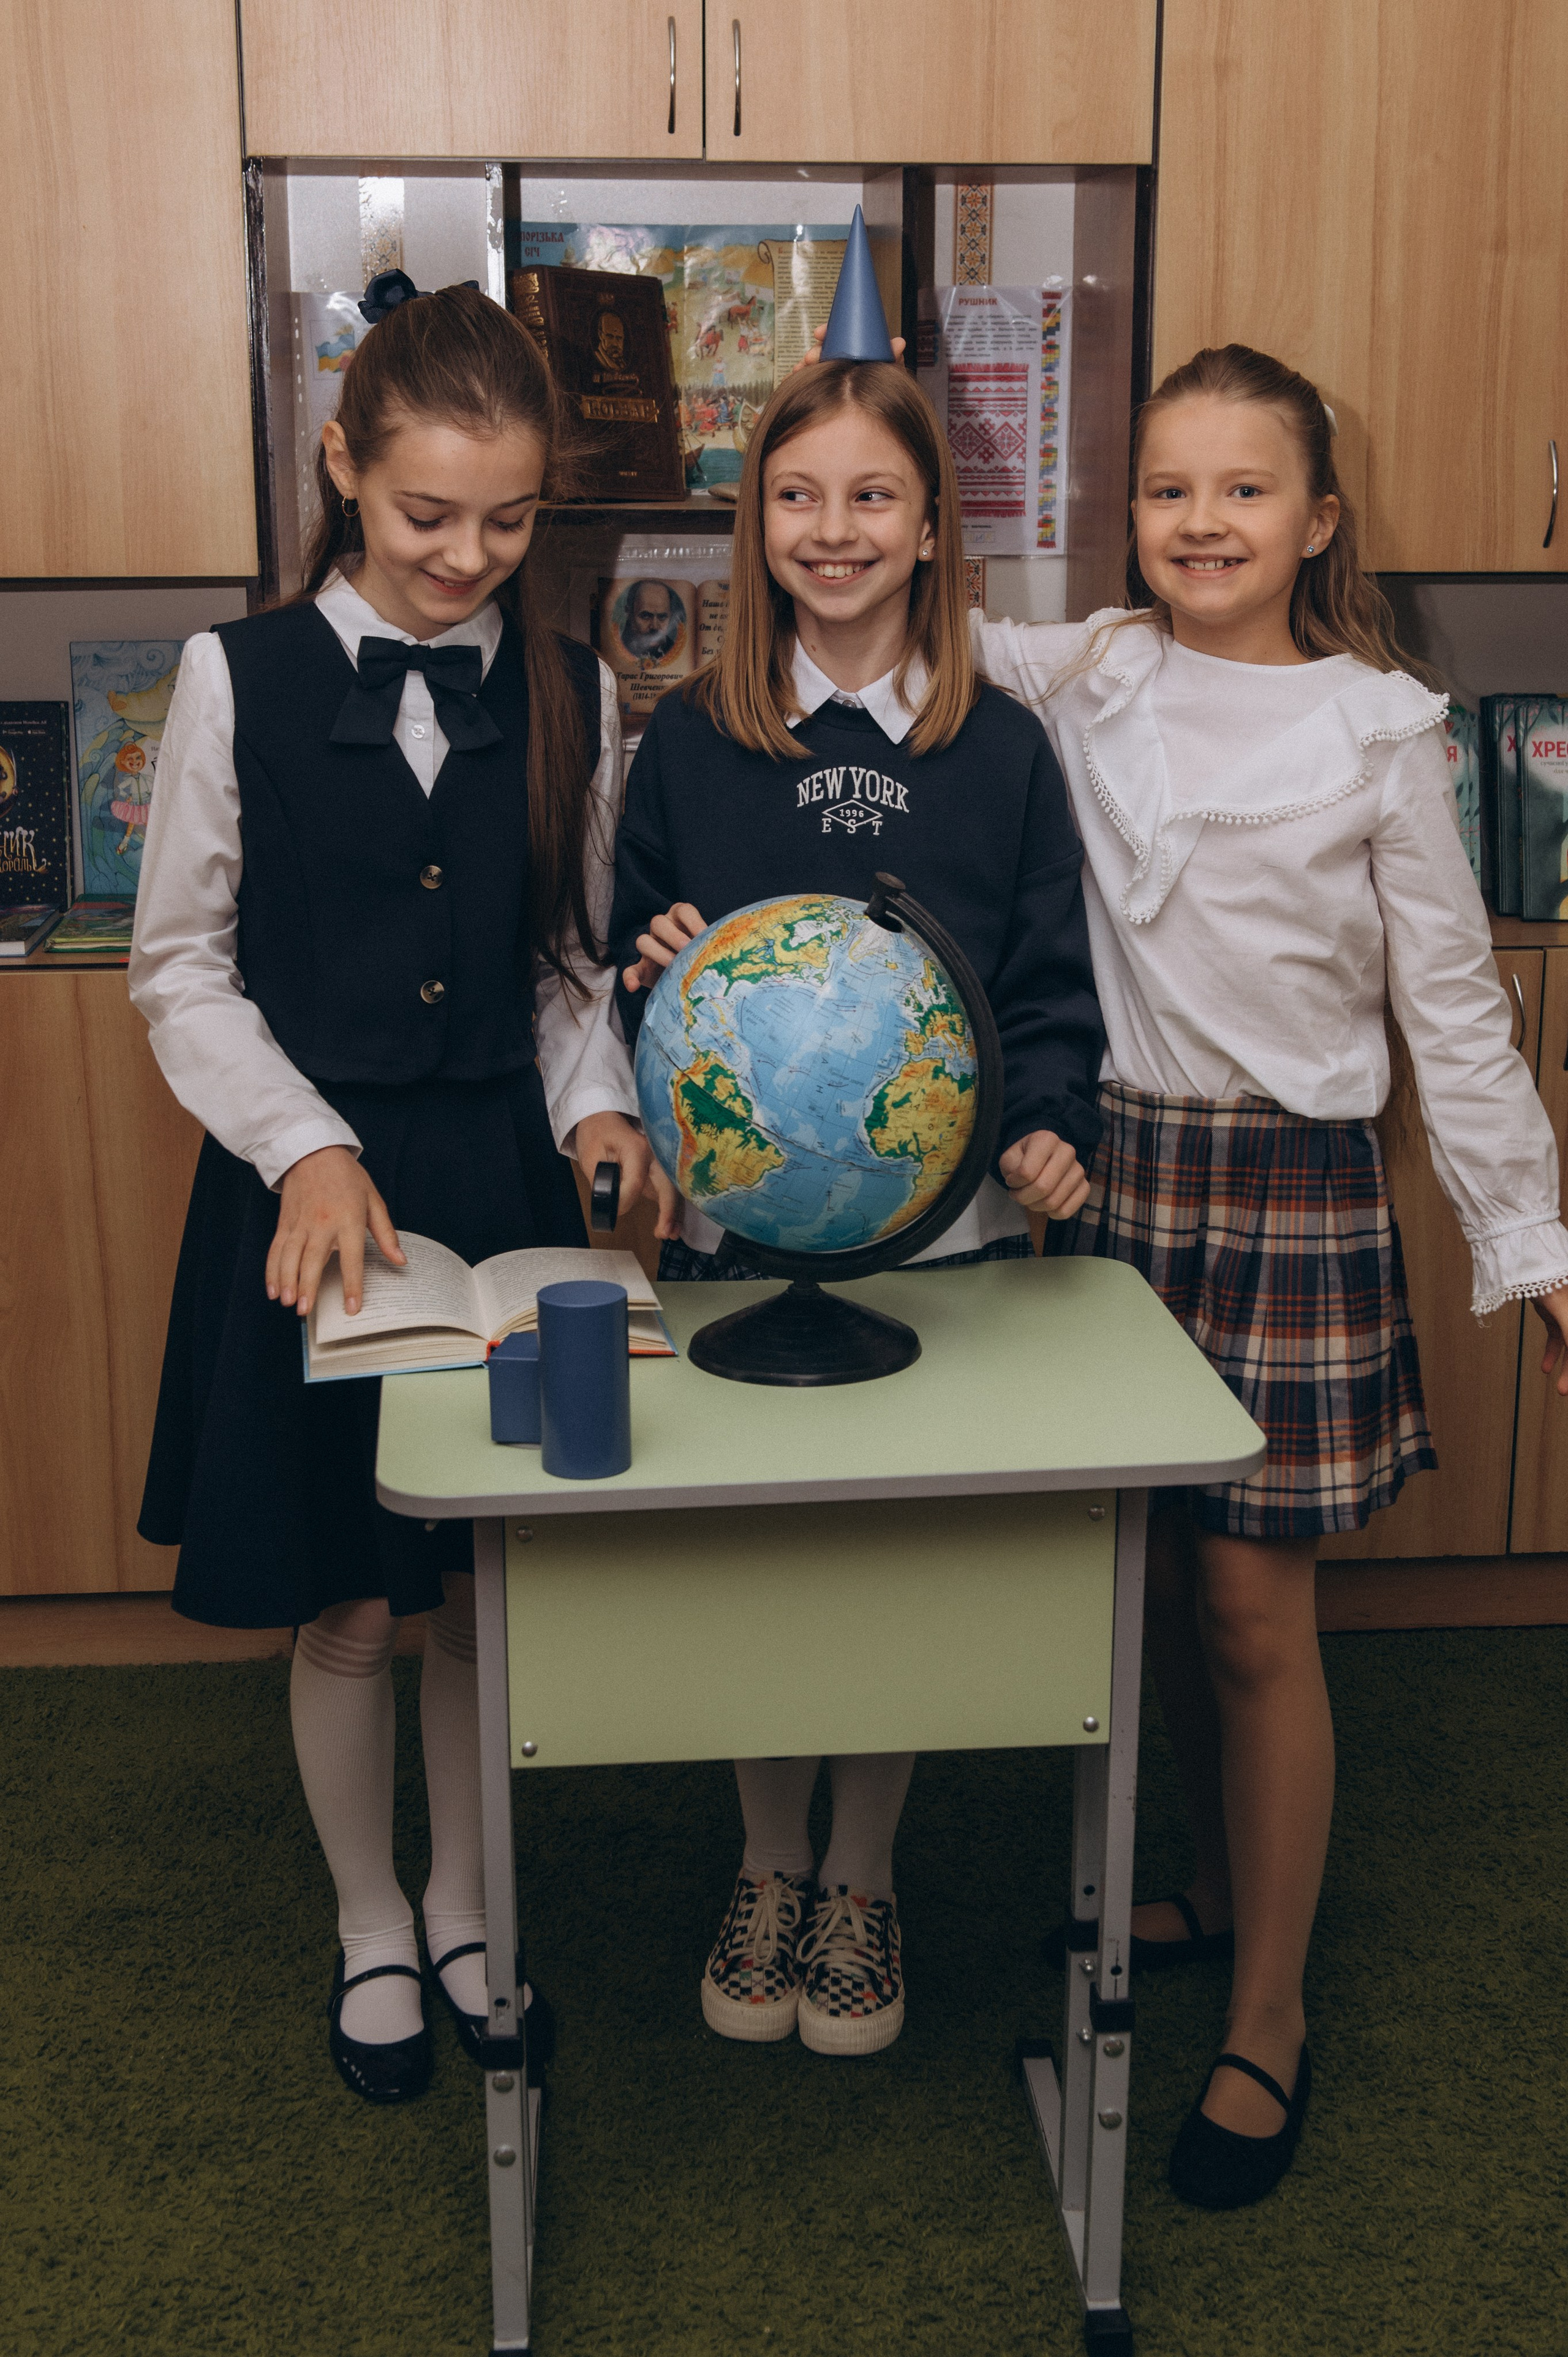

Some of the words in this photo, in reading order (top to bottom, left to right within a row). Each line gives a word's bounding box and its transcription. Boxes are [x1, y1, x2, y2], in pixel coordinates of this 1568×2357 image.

[959, 297, 998, 306] РУШНИК
[617, 672, 638, 681] Тарас
[639, 672, 684, 682] Григорович
[1532, 741, 1568, 758] ХРЕ
[796, 766, 846, 807] NEW
[849, 766, 910, 813] YORK
[839, 809, 864, 818] 1996
